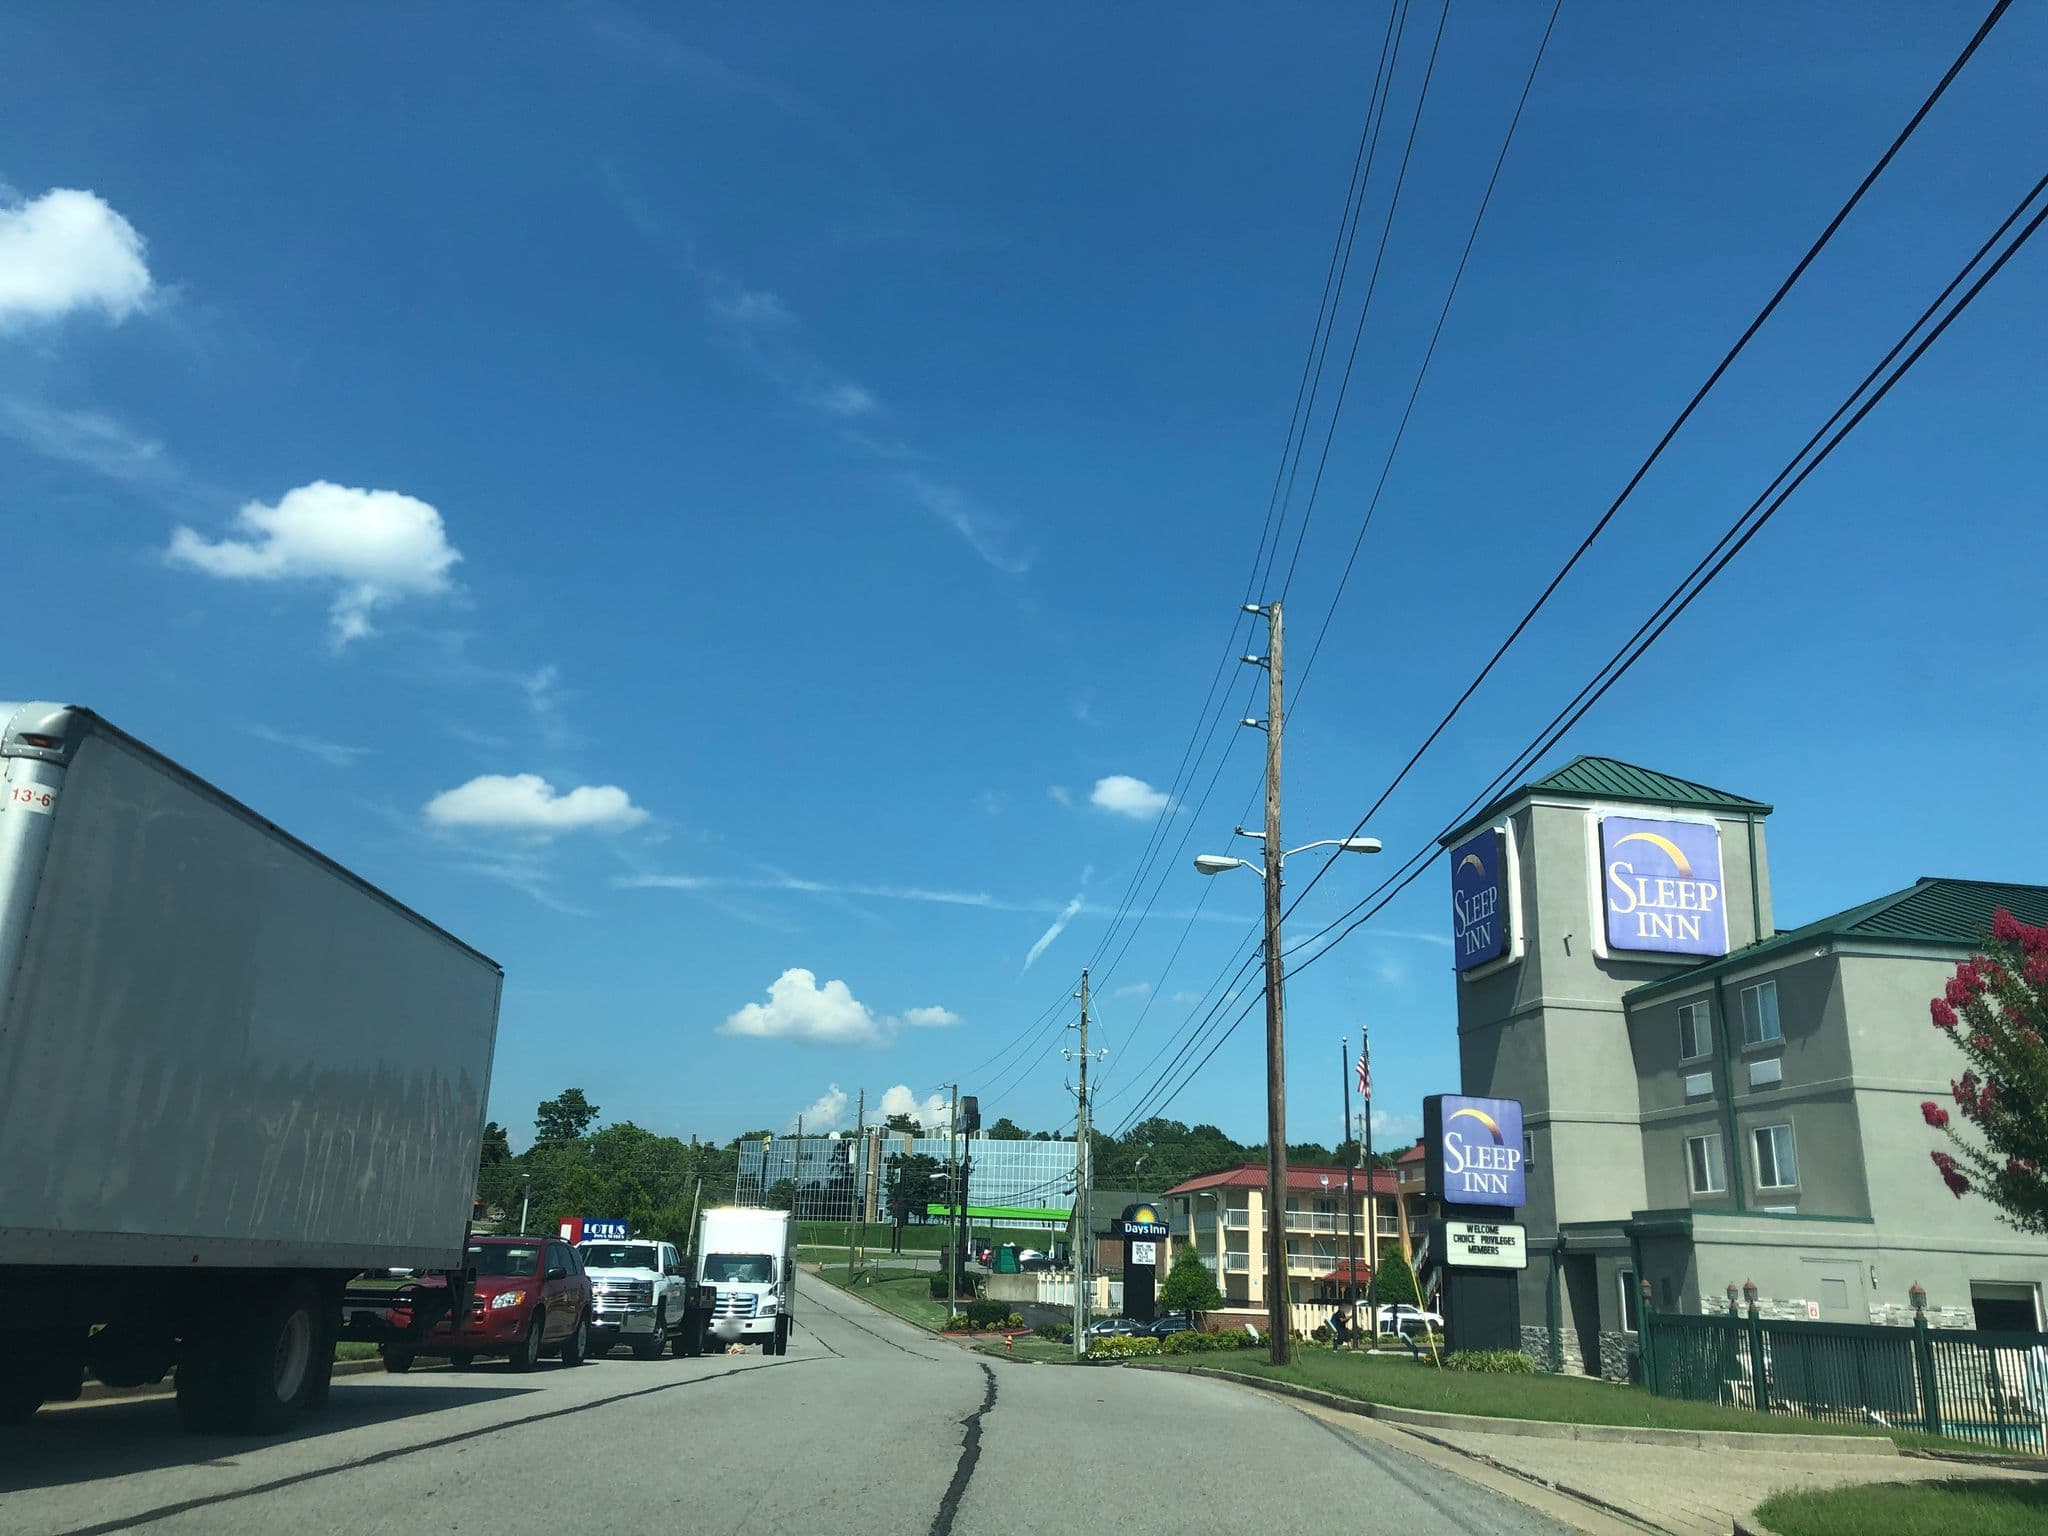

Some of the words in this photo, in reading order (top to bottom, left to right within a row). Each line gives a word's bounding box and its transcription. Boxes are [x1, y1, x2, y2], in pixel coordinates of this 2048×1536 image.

[1608, 861, 1718, 913] SLEEP
[1454, 886, 1498, 938] SLEEP
[1636, 911, 1701, 941] INN
[1464, 921, 1492, 956] INN
[1445, 1132, 1520, 1173] SLEEP
[1463, 1172, 1508, 1194] INN
[584, 1223, 625, 1234] LOTUS
[1125, 1223, 1149, 1235] Days
[1150, 1224, 1167, 1235] Inn
[1453, 1234, 1475, 1243] CHOICE
[1481, 1235, 1515, 1245] PRIVILEGES
[1467, 1224, 1499, 1234] WELCOME
[1468, 1245, 1499, 1255] MEMBERS
